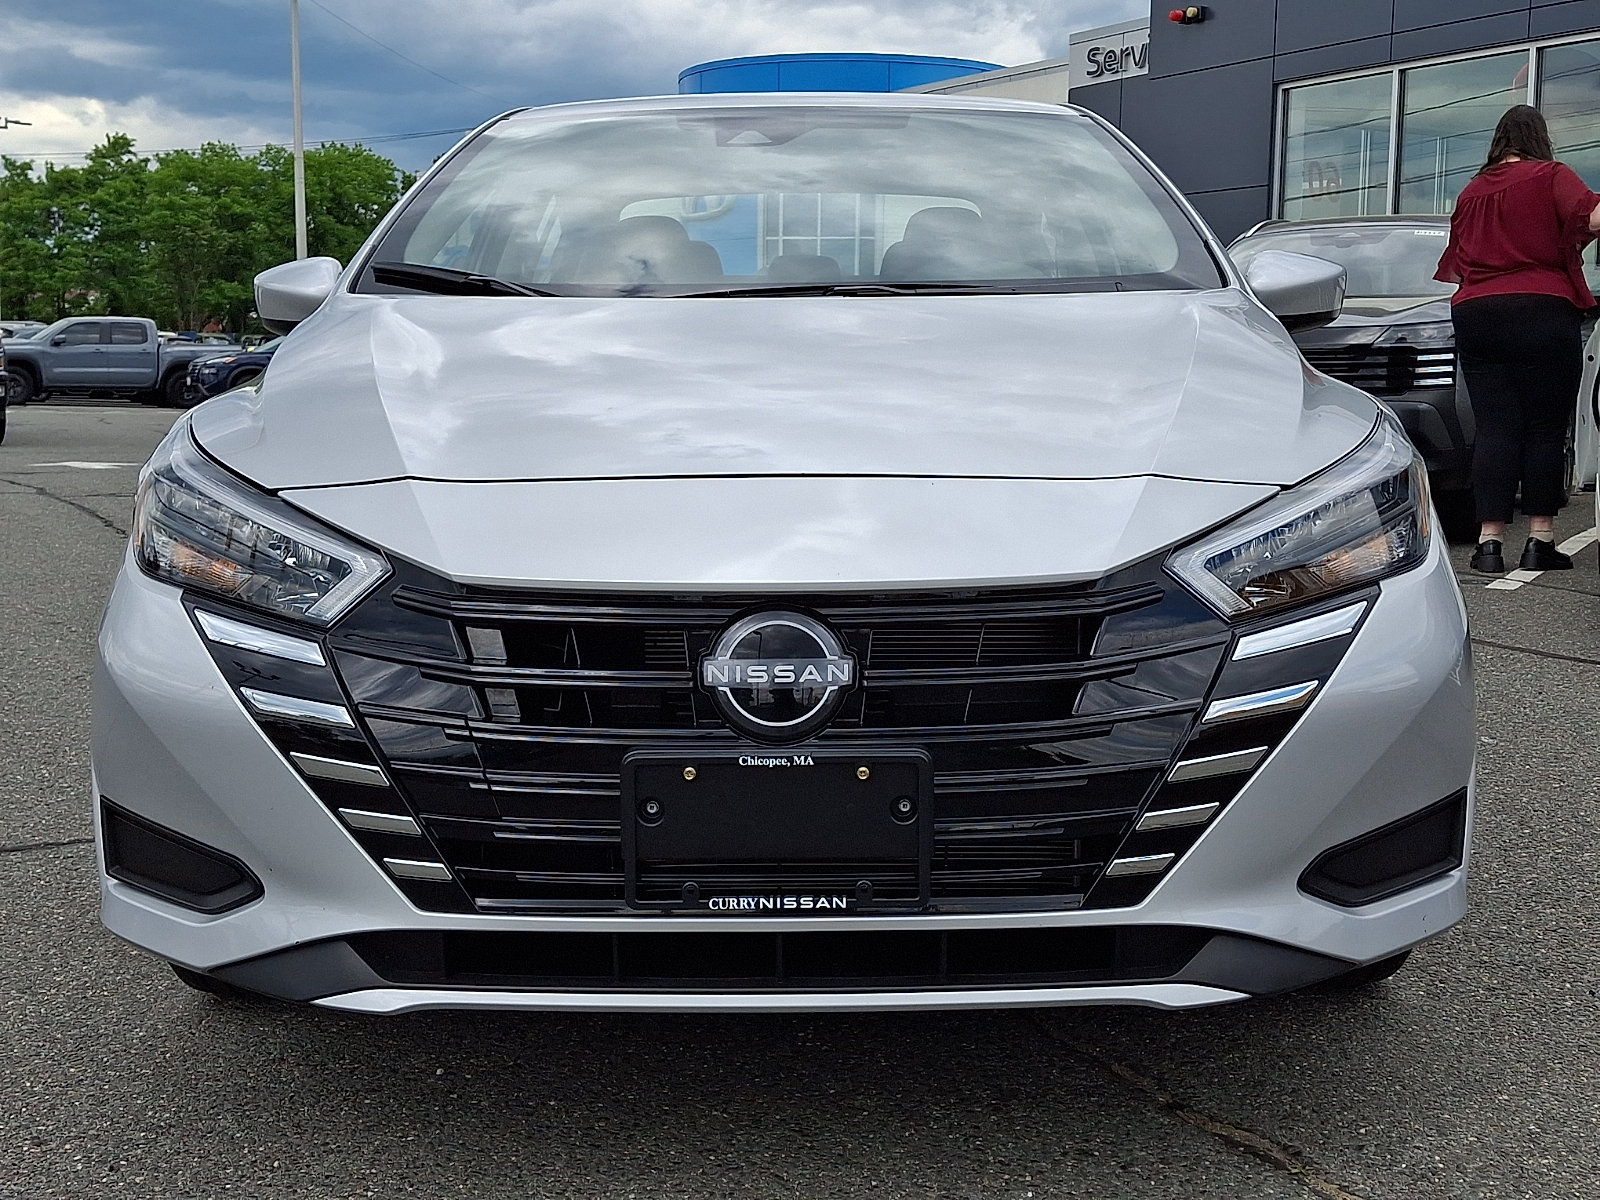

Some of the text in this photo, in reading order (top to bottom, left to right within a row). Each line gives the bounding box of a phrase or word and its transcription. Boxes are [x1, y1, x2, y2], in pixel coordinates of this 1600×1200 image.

[1086, 42, 1150, 77] Serv
[707, 664, 849, 683] NISSAN
[738, 755, 815, 768] Chicopee, MA
